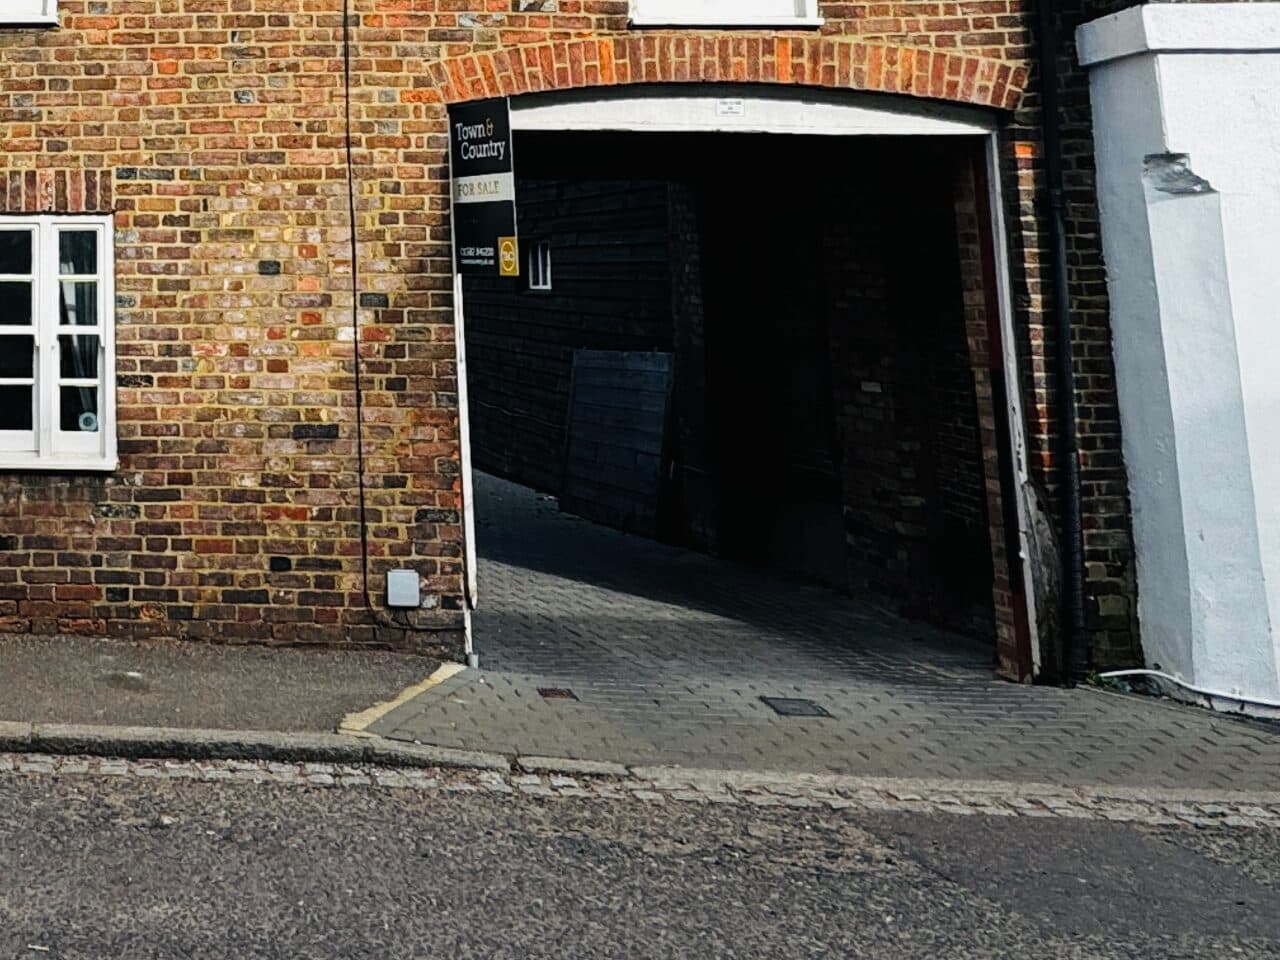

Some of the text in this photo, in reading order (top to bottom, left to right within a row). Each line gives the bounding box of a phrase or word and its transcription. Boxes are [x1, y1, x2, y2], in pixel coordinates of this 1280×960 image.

[461, 140, 505, 160] Country
[457, 180, 500, 197] FOR SALE
